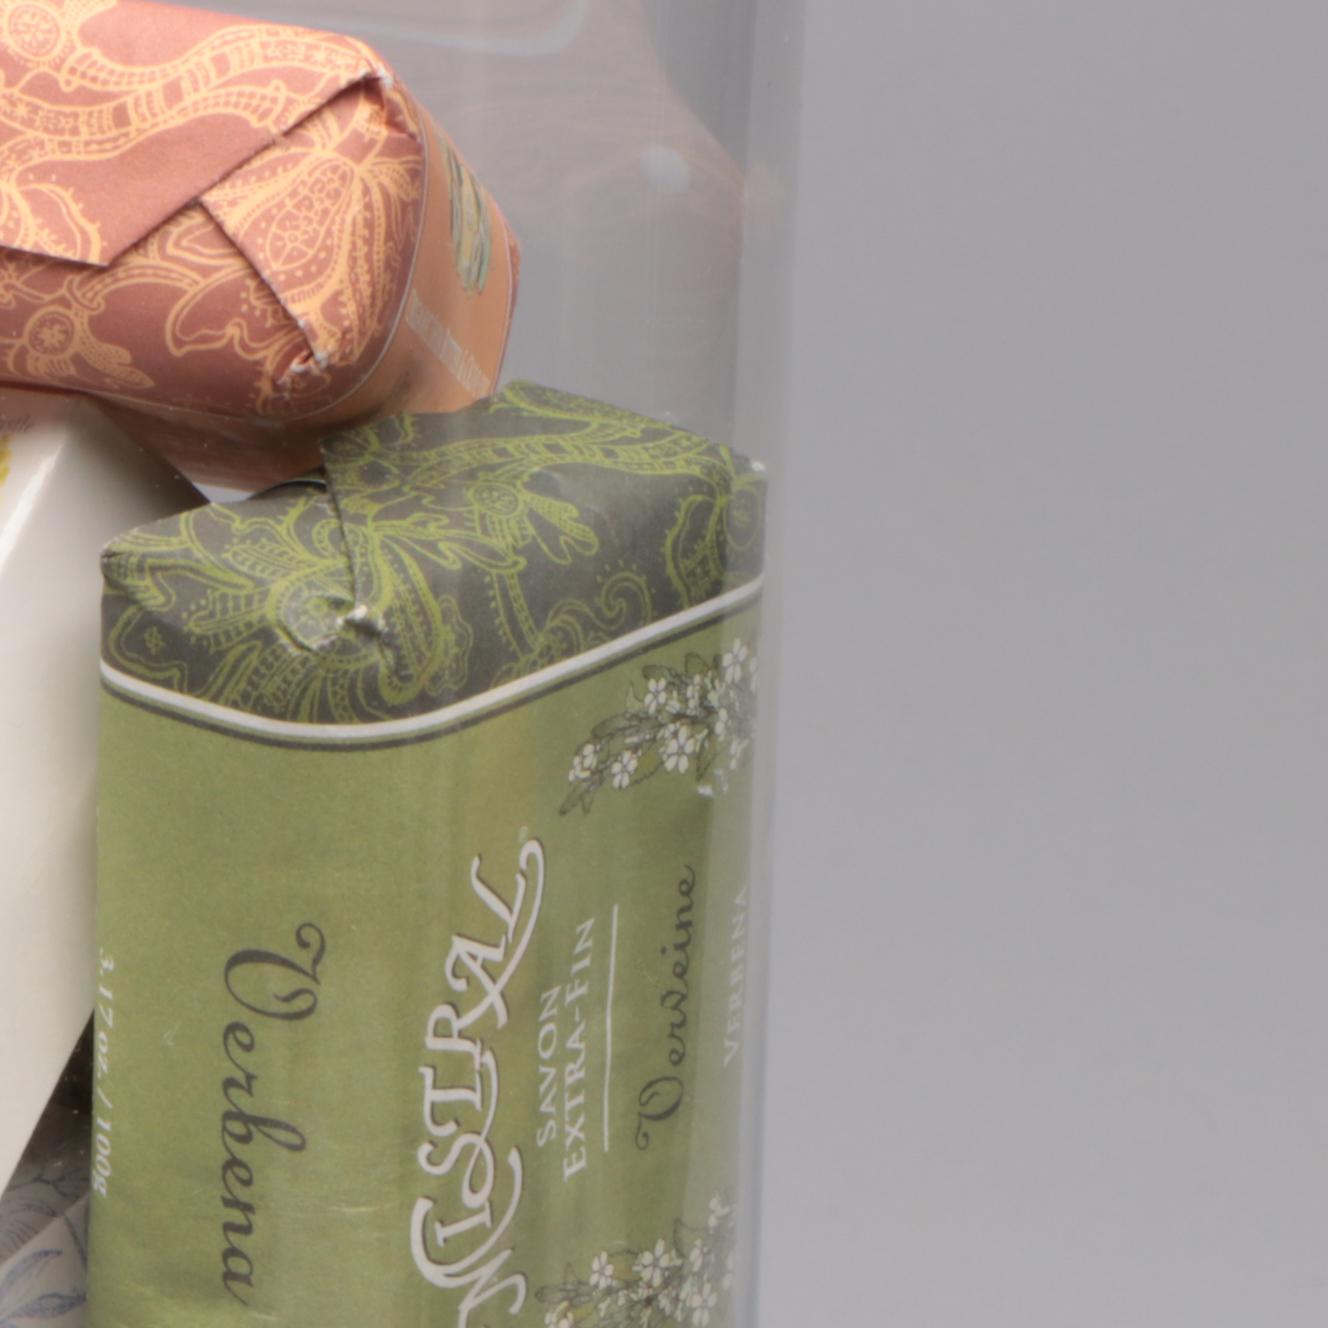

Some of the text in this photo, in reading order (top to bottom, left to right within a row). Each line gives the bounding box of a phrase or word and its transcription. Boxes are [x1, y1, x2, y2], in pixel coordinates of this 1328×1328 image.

[219, 921, 328, 1307] Verbena
[536, 984, 562, 1149] SAVON
[563, 917, 596, 1182] EXTRA-FIN
[634, 863, 697, 1152] Verveine
[92, 1116, 113, 1198] 100g
